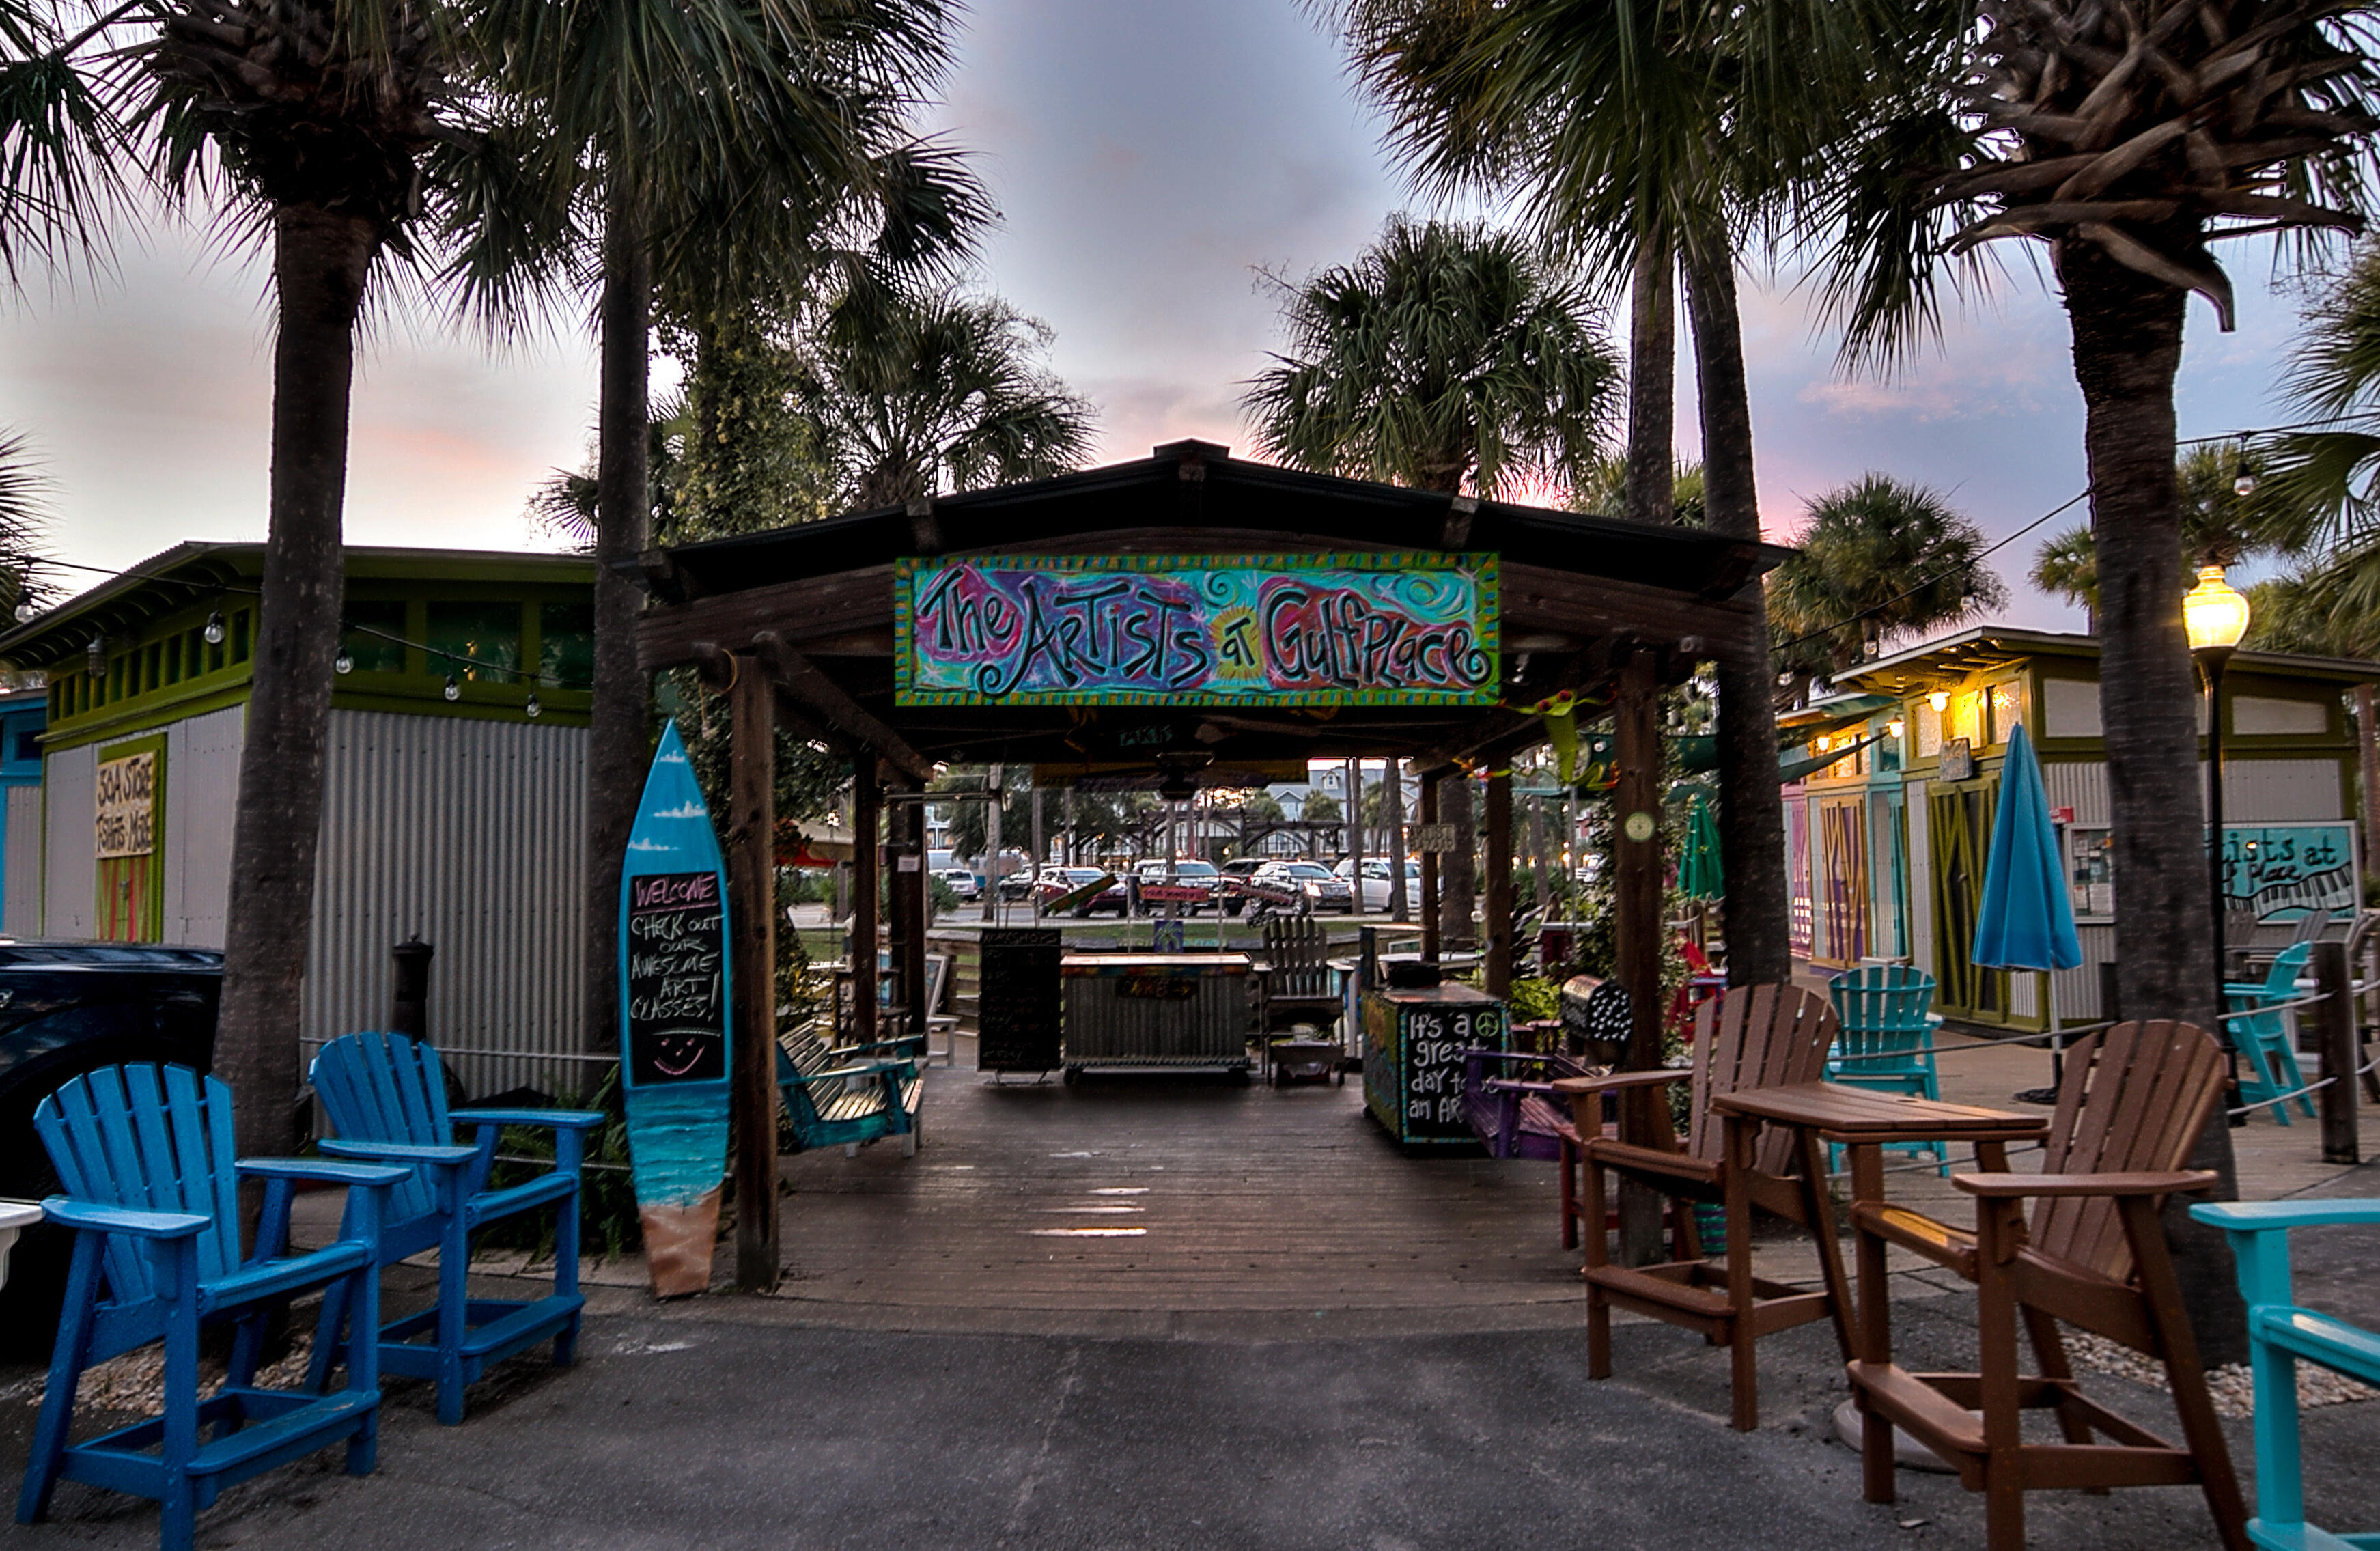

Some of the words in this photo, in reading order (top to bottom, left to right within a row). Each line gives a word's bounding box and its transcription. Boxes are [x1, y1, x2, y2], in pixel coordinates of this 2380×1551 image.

[919, 569, 1014, 654] The
[2222, 829, 2293, 863] ists
[2304, 835, 2336, 865] at
[635, 874, 717, 907] WELCOME
[631, 951, 720, 980] AWESOME
[660, 975, 710, 998] ART
[1410, 1012, 1443, 1040] It's
[1453, 1012, 1471, 1037] a
[1409, 1098, 1431, 1120] an
[1438, 1095, 1464, 1123] AR
